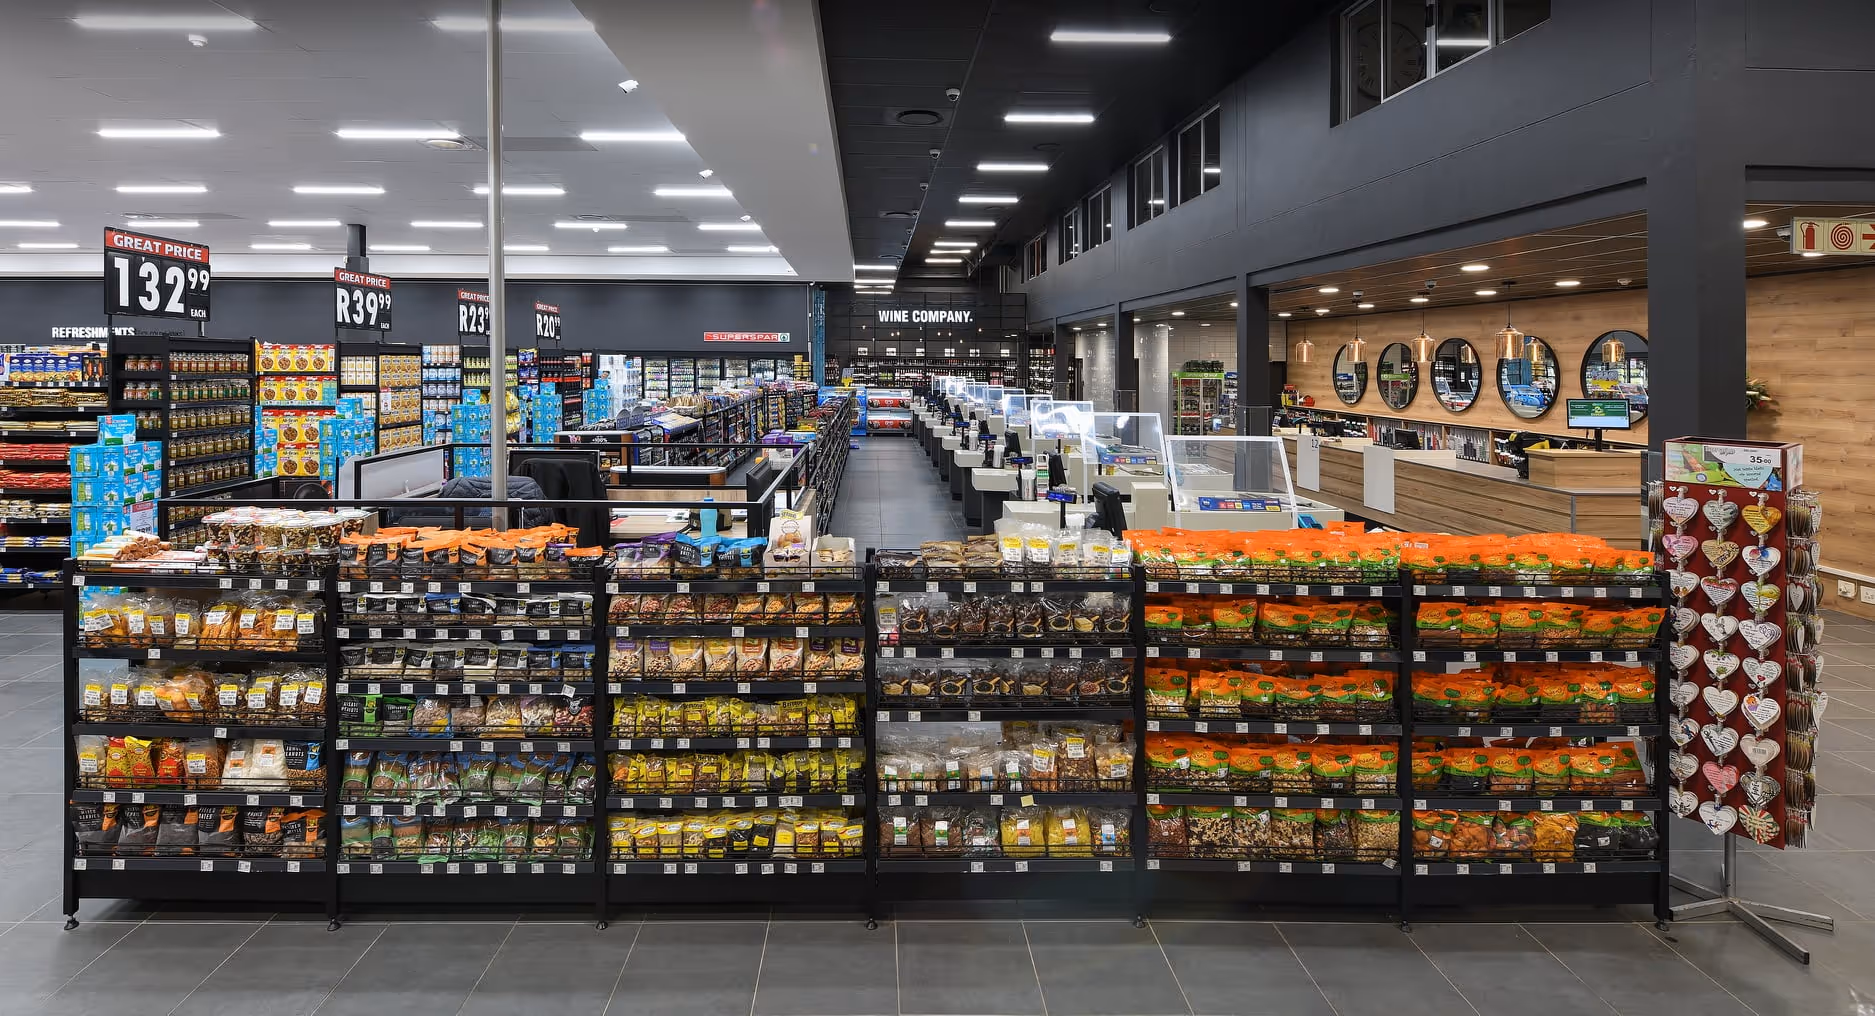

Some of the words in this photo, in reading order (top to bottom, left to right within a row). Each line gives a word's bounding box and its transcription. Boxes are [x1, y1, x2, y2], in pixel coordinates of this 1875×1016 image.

[113, 233, 162, 254] GREAT
[164, 243, 203, 261] PRICE
[339, 271, 364, 284] GREAT
[366, 276, 387, 288] PRICE
[460, 291, 476, 300] GREAT
[190, 308, 206, 319] EACH
[878, 310, 909, 323] WINE
